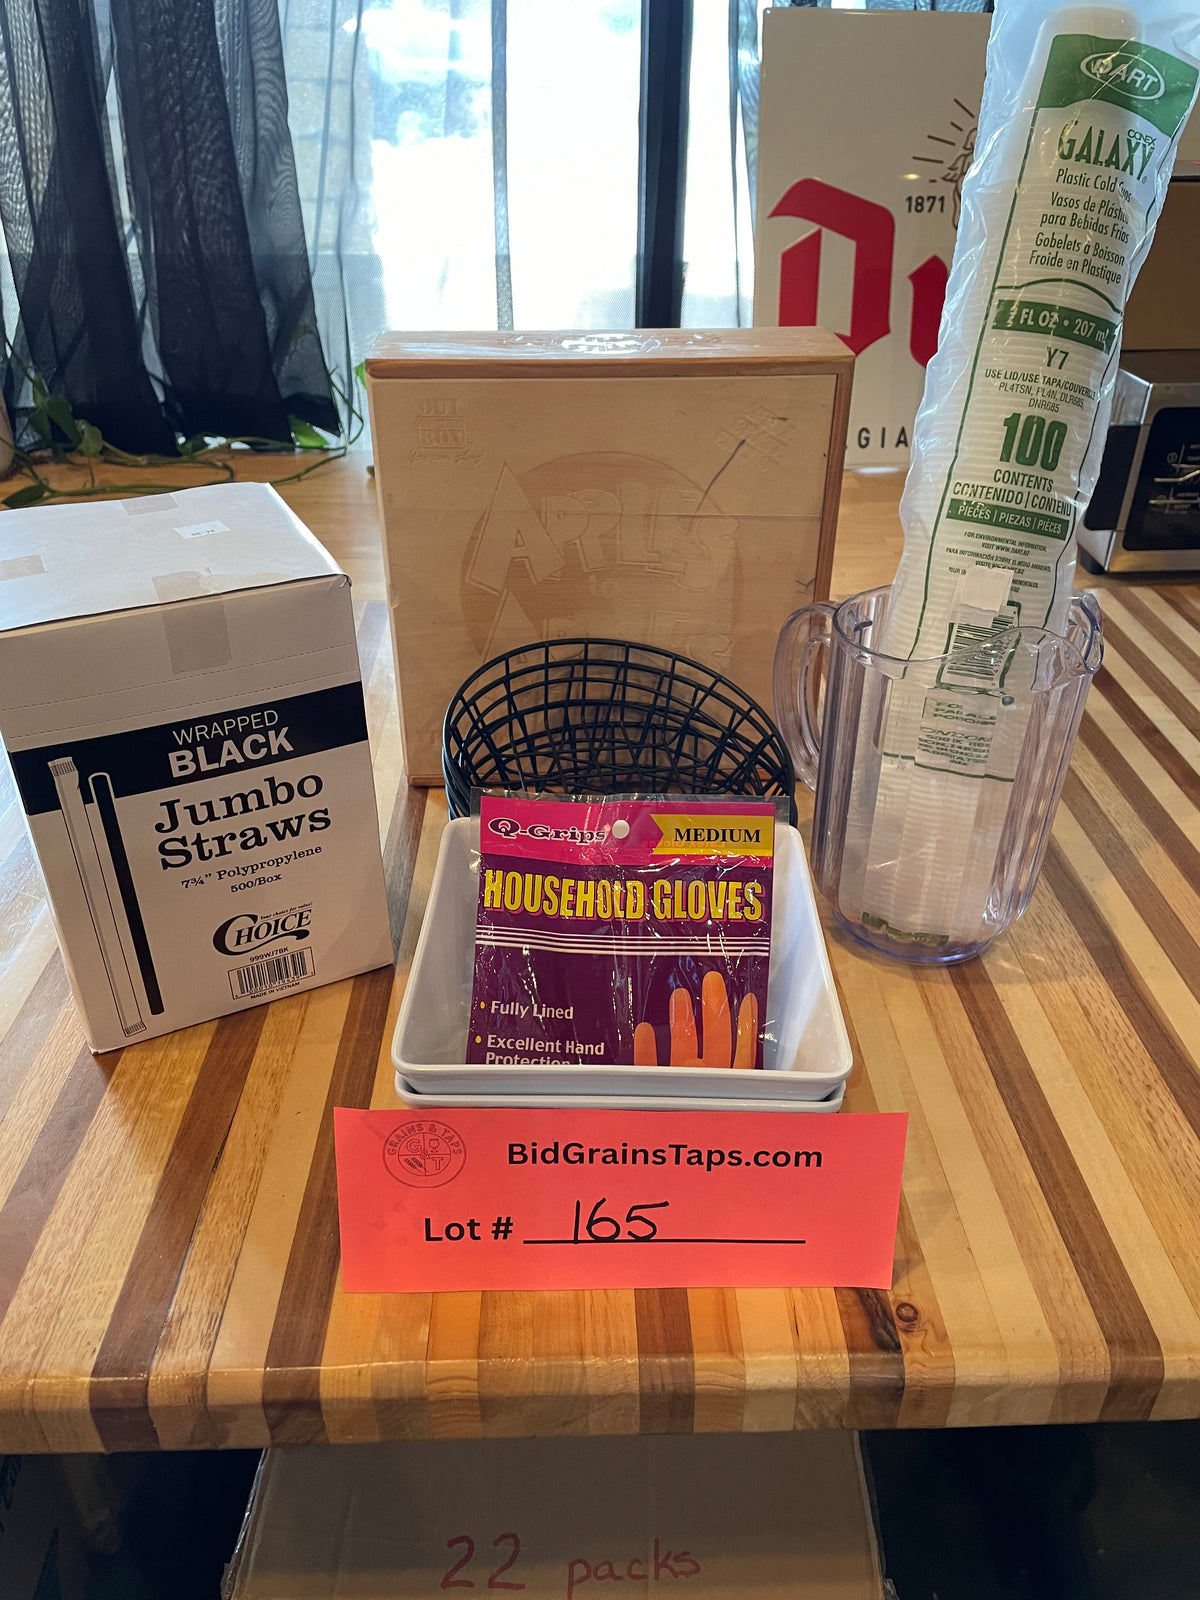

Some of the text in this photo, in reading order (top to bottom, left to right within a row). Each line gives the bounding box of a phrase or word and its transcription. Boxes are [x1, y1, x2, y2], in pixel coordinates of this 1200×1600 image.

[1058, 120, 1155, 181] GALAXY
[1127, 128, 1157, 146] CONEX
[1056, 168, 1091, 189] Plastic
[1094, 175, 1118, 194] Cold
[905, 196, 945, 213] 1871
[1050, 191, 1080, 209] Vasos
[1083, 194, 1096, 211] de
[1040, 213, 1066, 228] para
[1070, 213, 1108, 236] Bebidas
[1035, 232, 1081, 252] Gobelets
[1093, 241, 1126, 267] Boisson
[1029, 251, 1122, 284] Froide en Plastique
[1019, 308, 1034, 325] FL
[1038, 310, 1059, 328] OZ
[1073, 318, 1096, 338] 207
[1046, 347, 1069, 370] Y7
[985, 368, 1003, 379] USE
[1004, 369, 1040, 384] LID/USE
[999, 412, 1068, 472] 100
[993, 468, 1054, 493] CONTENTS
[952, 481, 1072, 517] CONTENIDO CONTENU
[957, 505, 992, 520] PIECES
[999, 511, 1032, 528] PIEZAS
[172, 710, 279, 746] WRAPPED
[168, 726, 294, 778] BLACK
[154, 775, 323, 833] Jumbo
[158, 808, 331, 870] Straws
[488, 817, 607, 845] Q-Grips
[673, 827, 761, 843] MEDIUM
[217, 846, 322, 880] Polypropylene
[230, 874, 282, 893] 500/Box
[483, 868, 766, 922] HOUSEHOLD GLOVES
[213, 909, 312, 956] CHOICE
[250, 991, 268, 1000] MADE
[275, 981, 301, 993] VIETNAM
[490, 1000, 574, 1020] Fully Lined
[487, 1034, 605, 1055] Excellent Hand
[441, 1128, 462, 1155] TAPS
[507, 1142, 823, 1172] BidGrainsTaps.com
[423, 1216, 514, 1242] Lot #
[572, 1197, 671, 1245] 165
[440, 1532, 701, 1600] 22 packs
